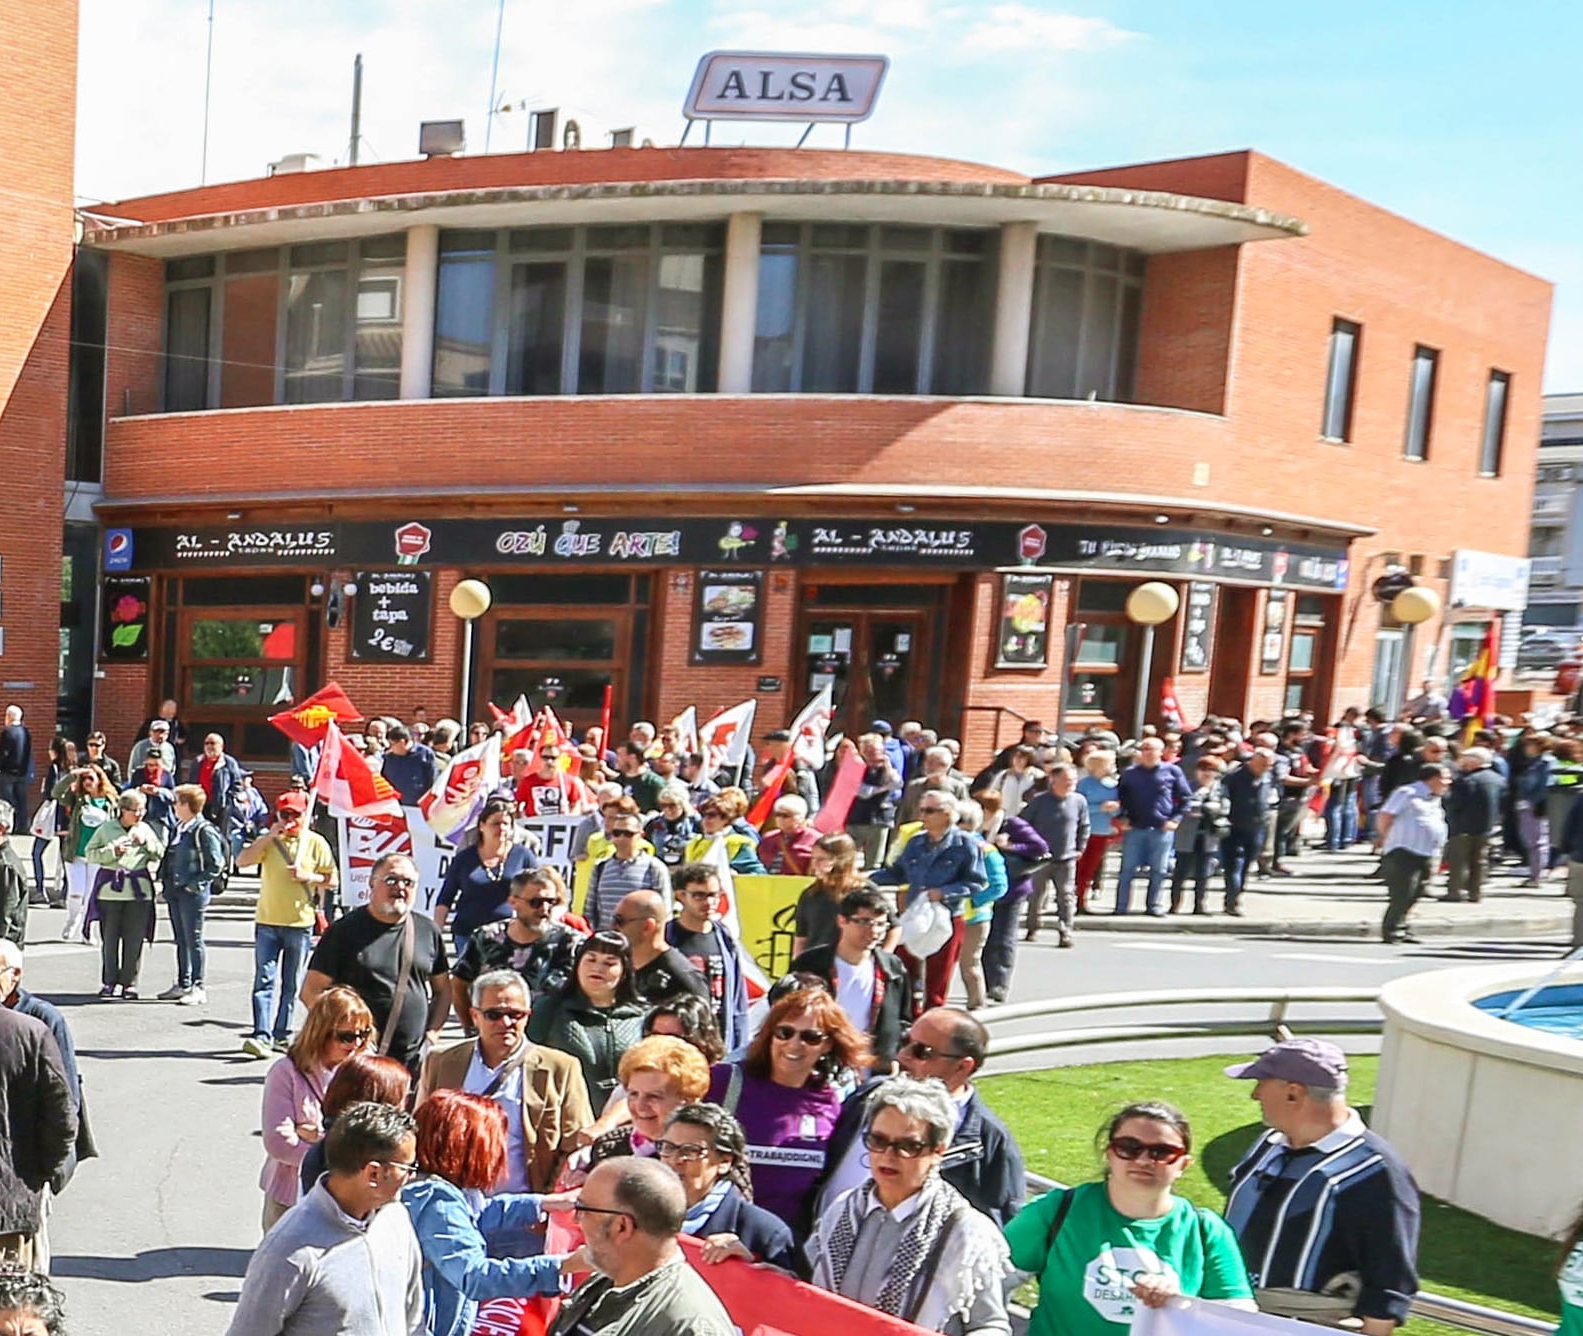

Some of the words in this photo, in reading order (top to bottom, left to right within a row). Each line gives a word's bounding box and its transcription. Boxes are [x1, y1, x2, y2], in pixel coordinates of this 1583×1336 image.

[715, 69, 855, 103] ALSA
[176, 534, 203, 550] AL
[228, 532, 332, 552] ANDALUS
[496, 525, 548, 556] OZÚ
[554, 532, 602, 557] QUE
[609, 530, 682, 558] ARTE!
[812, 529, 843, 544] AL
[868, 528, 972, 548] ANDALUS
[369, 582, 420, 594] bebida
[372, 609, 408, 624] tapa
[1093, 1288, 1137, 1303] DESAH
